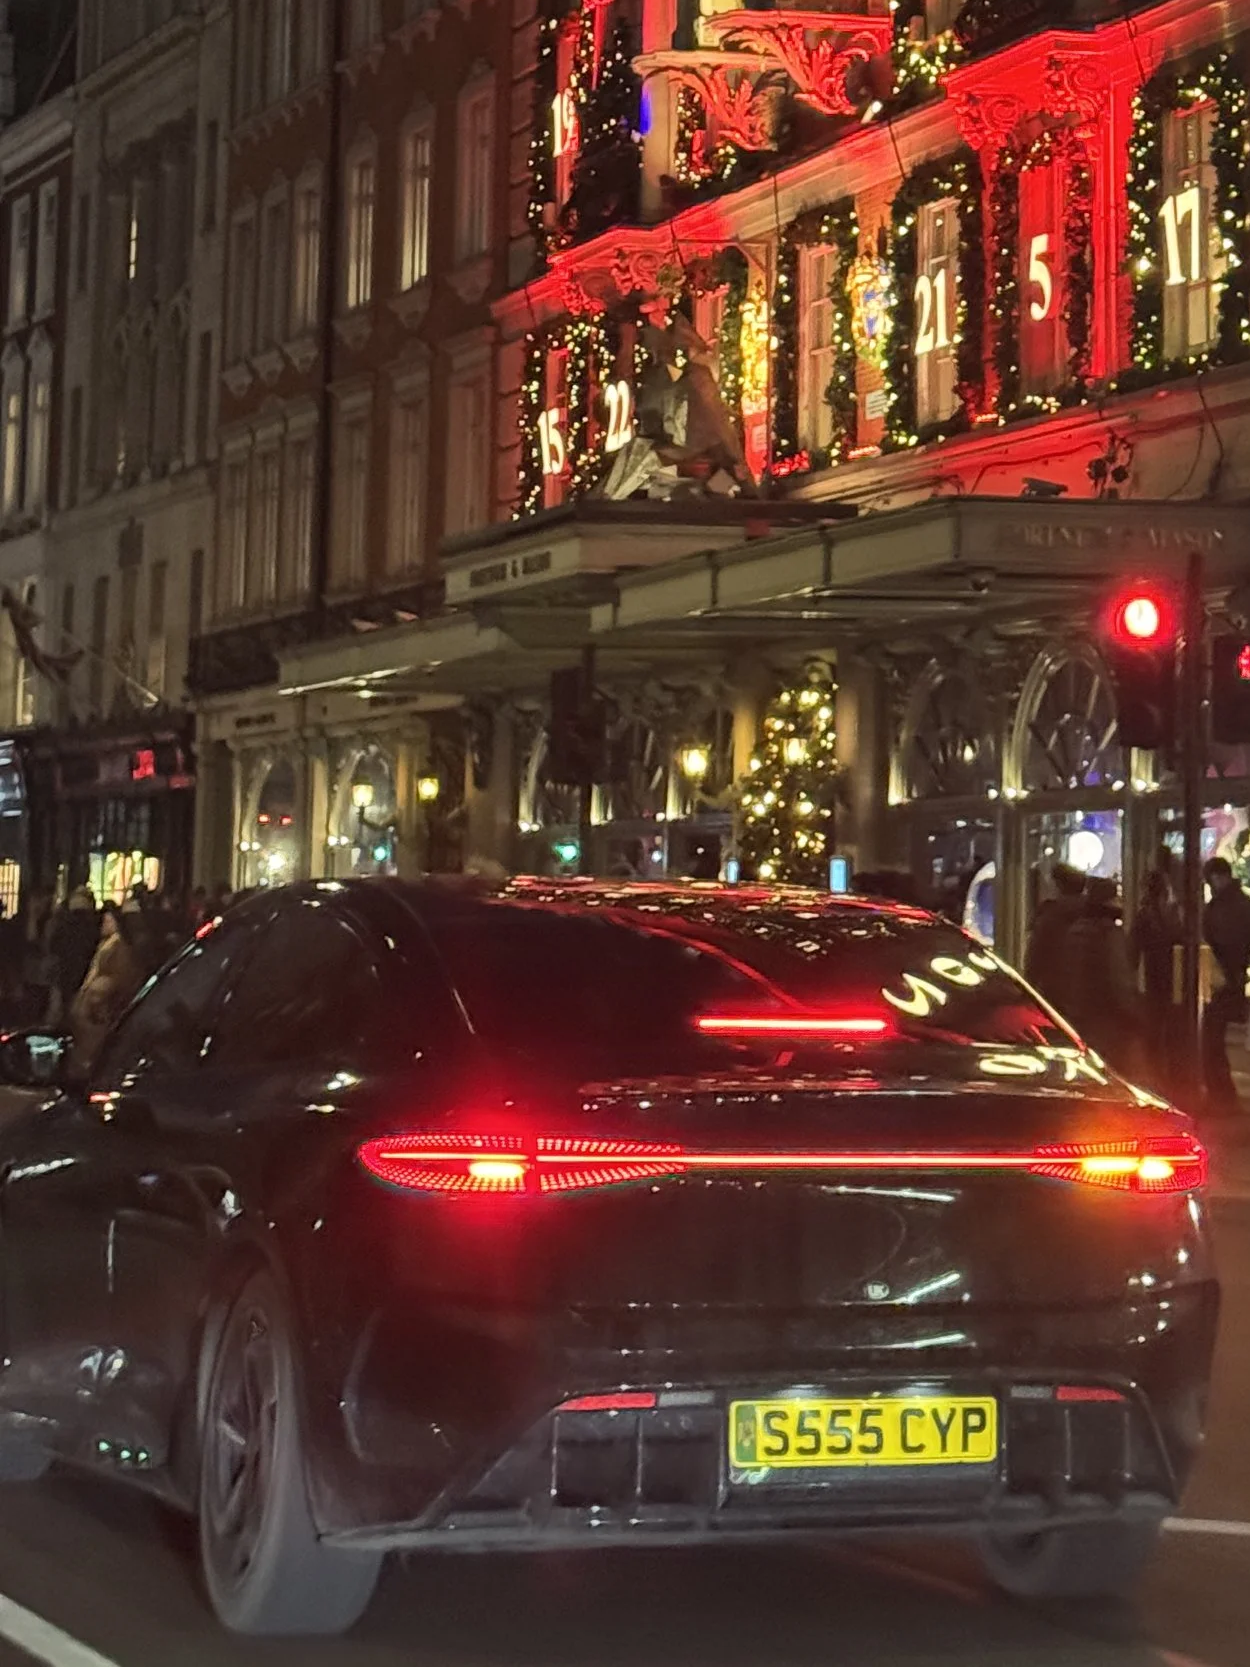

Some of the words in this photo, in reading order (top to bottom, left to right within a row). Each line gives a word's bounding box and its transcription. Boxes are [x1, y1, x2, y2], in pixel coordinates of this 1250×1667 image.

[1158, 185, 1201, 286] 17
[914, 268, 951, 357] 21
[1028, 233, 1053, 323] 5
[536, 407, 566, 476] 15
[603, 379, 632, 454] 22
[762, 1408, 884, 1456] S555
[900, 1406, 988, 1454] CYP
